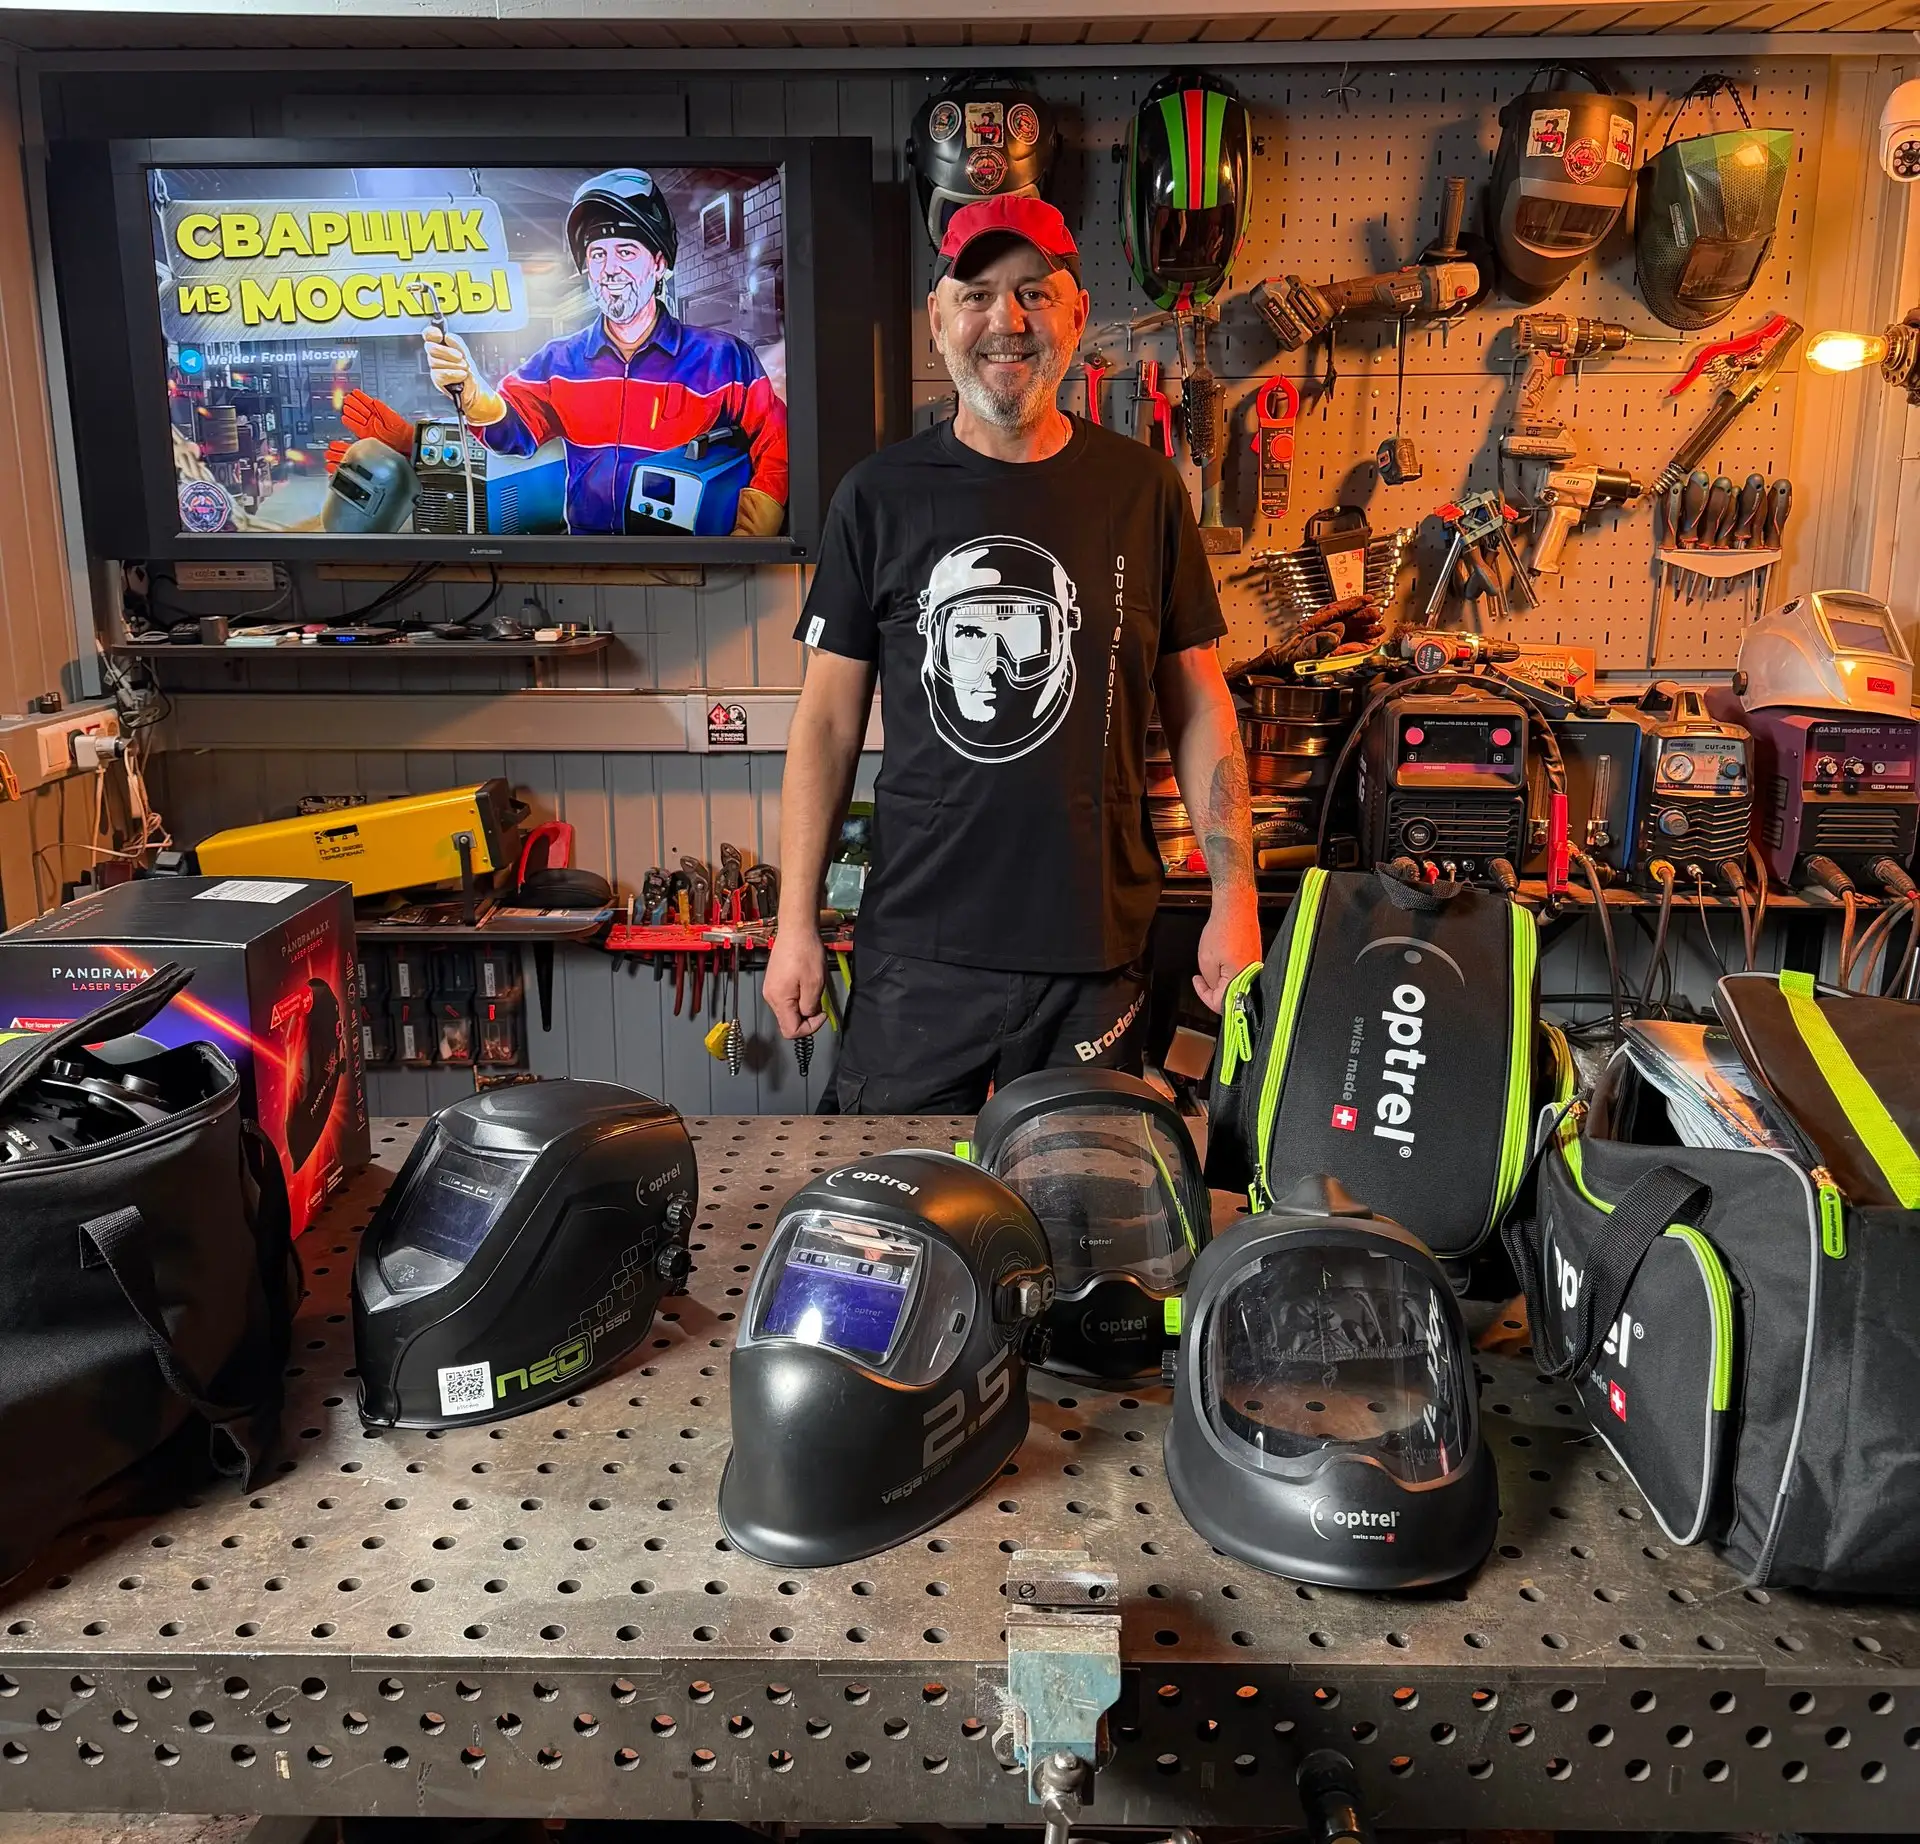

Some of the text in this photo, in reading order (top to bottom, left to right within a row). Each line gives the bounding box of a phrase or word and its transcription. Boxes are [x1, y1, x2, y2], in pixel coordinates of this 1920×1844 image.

[175, 209, 489, 261] СВАРЩИК
[240, 268, 512, 326] МОСКВЫ
[206, 348, 359, 366] Welder From Moscow
[1287, 821, 1310, 834] WIRE
[281, 919, 331, 957] PANORAMAXX
[51, 967, 158, 979] PANORAMA
[72, 983, 138, 991] LASER SER
[1343, 1016, 1365, 1101] swiss made
[649, 1163, 680, 1192] optrel
[852, 1171, 920, 1197] optrel
[1088, 1238, 1113, 1247] optrel
[1099, 1316, 1148, 1335] optrel
[1590, 1366, 1609, 1395] ade
[922, 1343, 1010, 1470] 2.5
[1333, 1509, 1396, 1529] optrel
[1352, 1533, 1369, 1541] swiss
